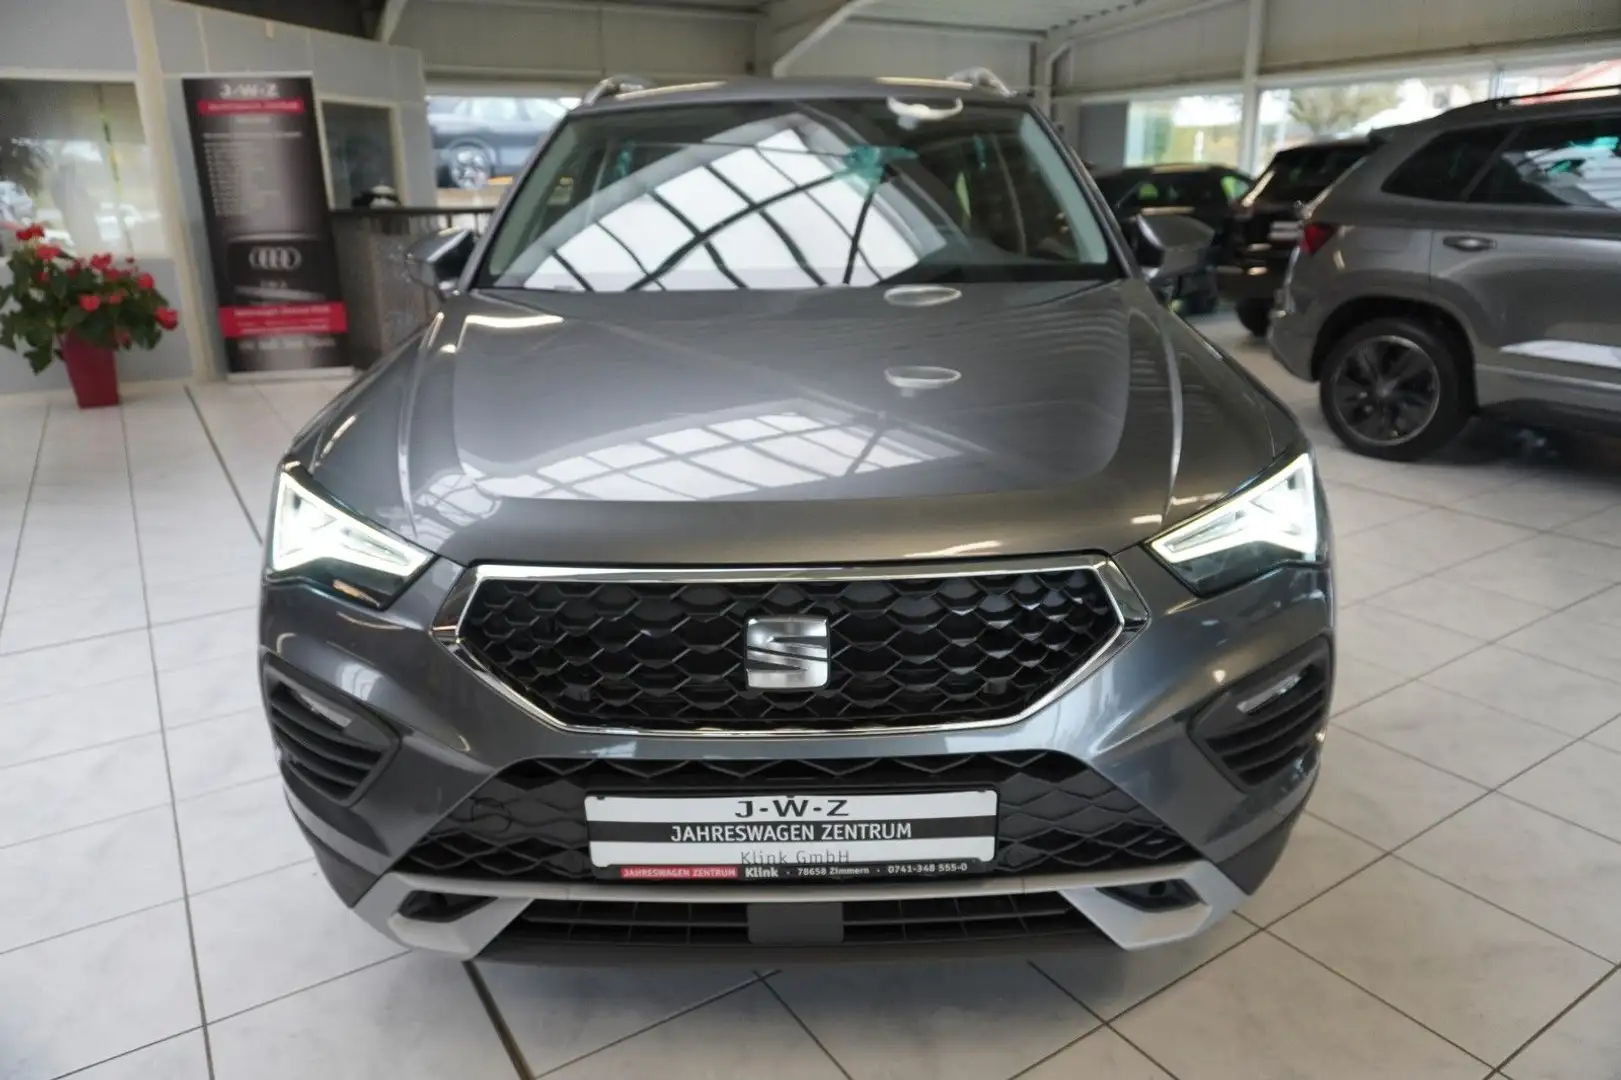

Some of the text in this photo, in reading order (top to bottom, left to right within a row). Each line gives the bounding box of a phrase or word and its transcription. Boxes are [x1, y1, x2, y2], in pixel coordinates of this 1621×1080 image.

[734, 799, 849, 818] J-W-Z
[670, 822, 912, 842] JAHRESWAGEN ZENTRUM
[740, 848, 850, 865] Klink GmbH
[623, 867, 691, 878] JAHRESWAGEN
[692, 867, 737, 878] ZENTRUM
[745, 866, 779, 879] Klink
[829, 866, 870, 876] Zimmern
